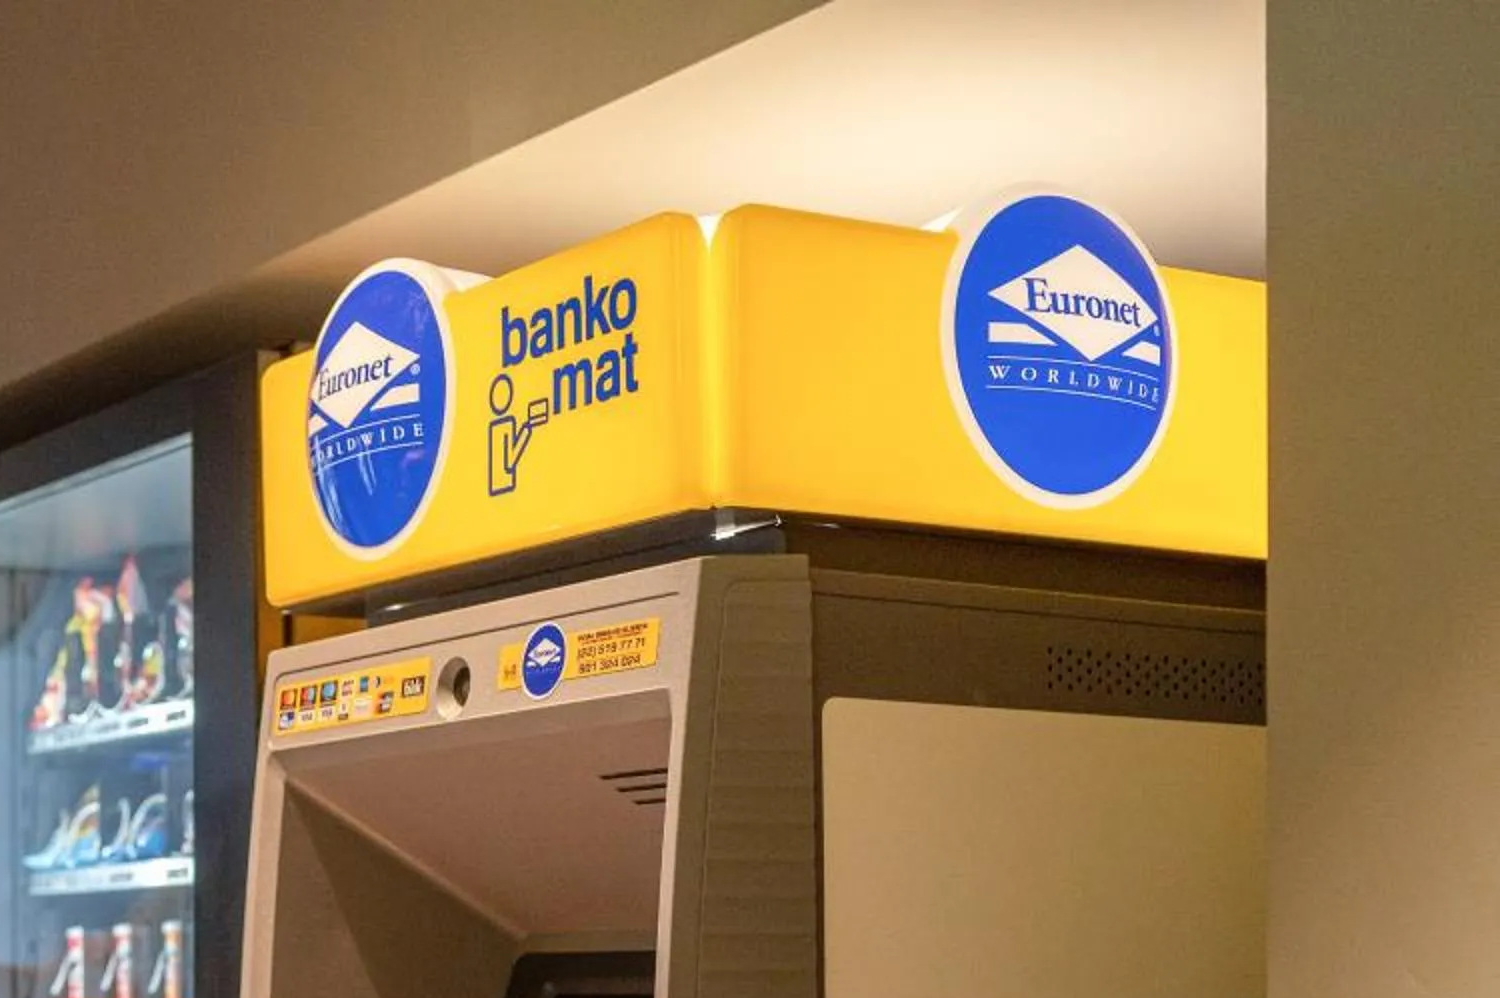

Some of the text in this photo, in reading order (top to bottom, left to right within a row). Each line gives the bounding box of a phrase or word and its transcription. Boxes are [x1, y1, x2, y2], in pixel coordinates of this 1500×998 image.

[501, 275, 637, 368] banko
[1023, 277, 1141, 328] Euronet
[318, 354, 395, 401] Euronet
[553, 333, 639, 414] mat
[988, 365, 1160, 403] WORLDWIDE
